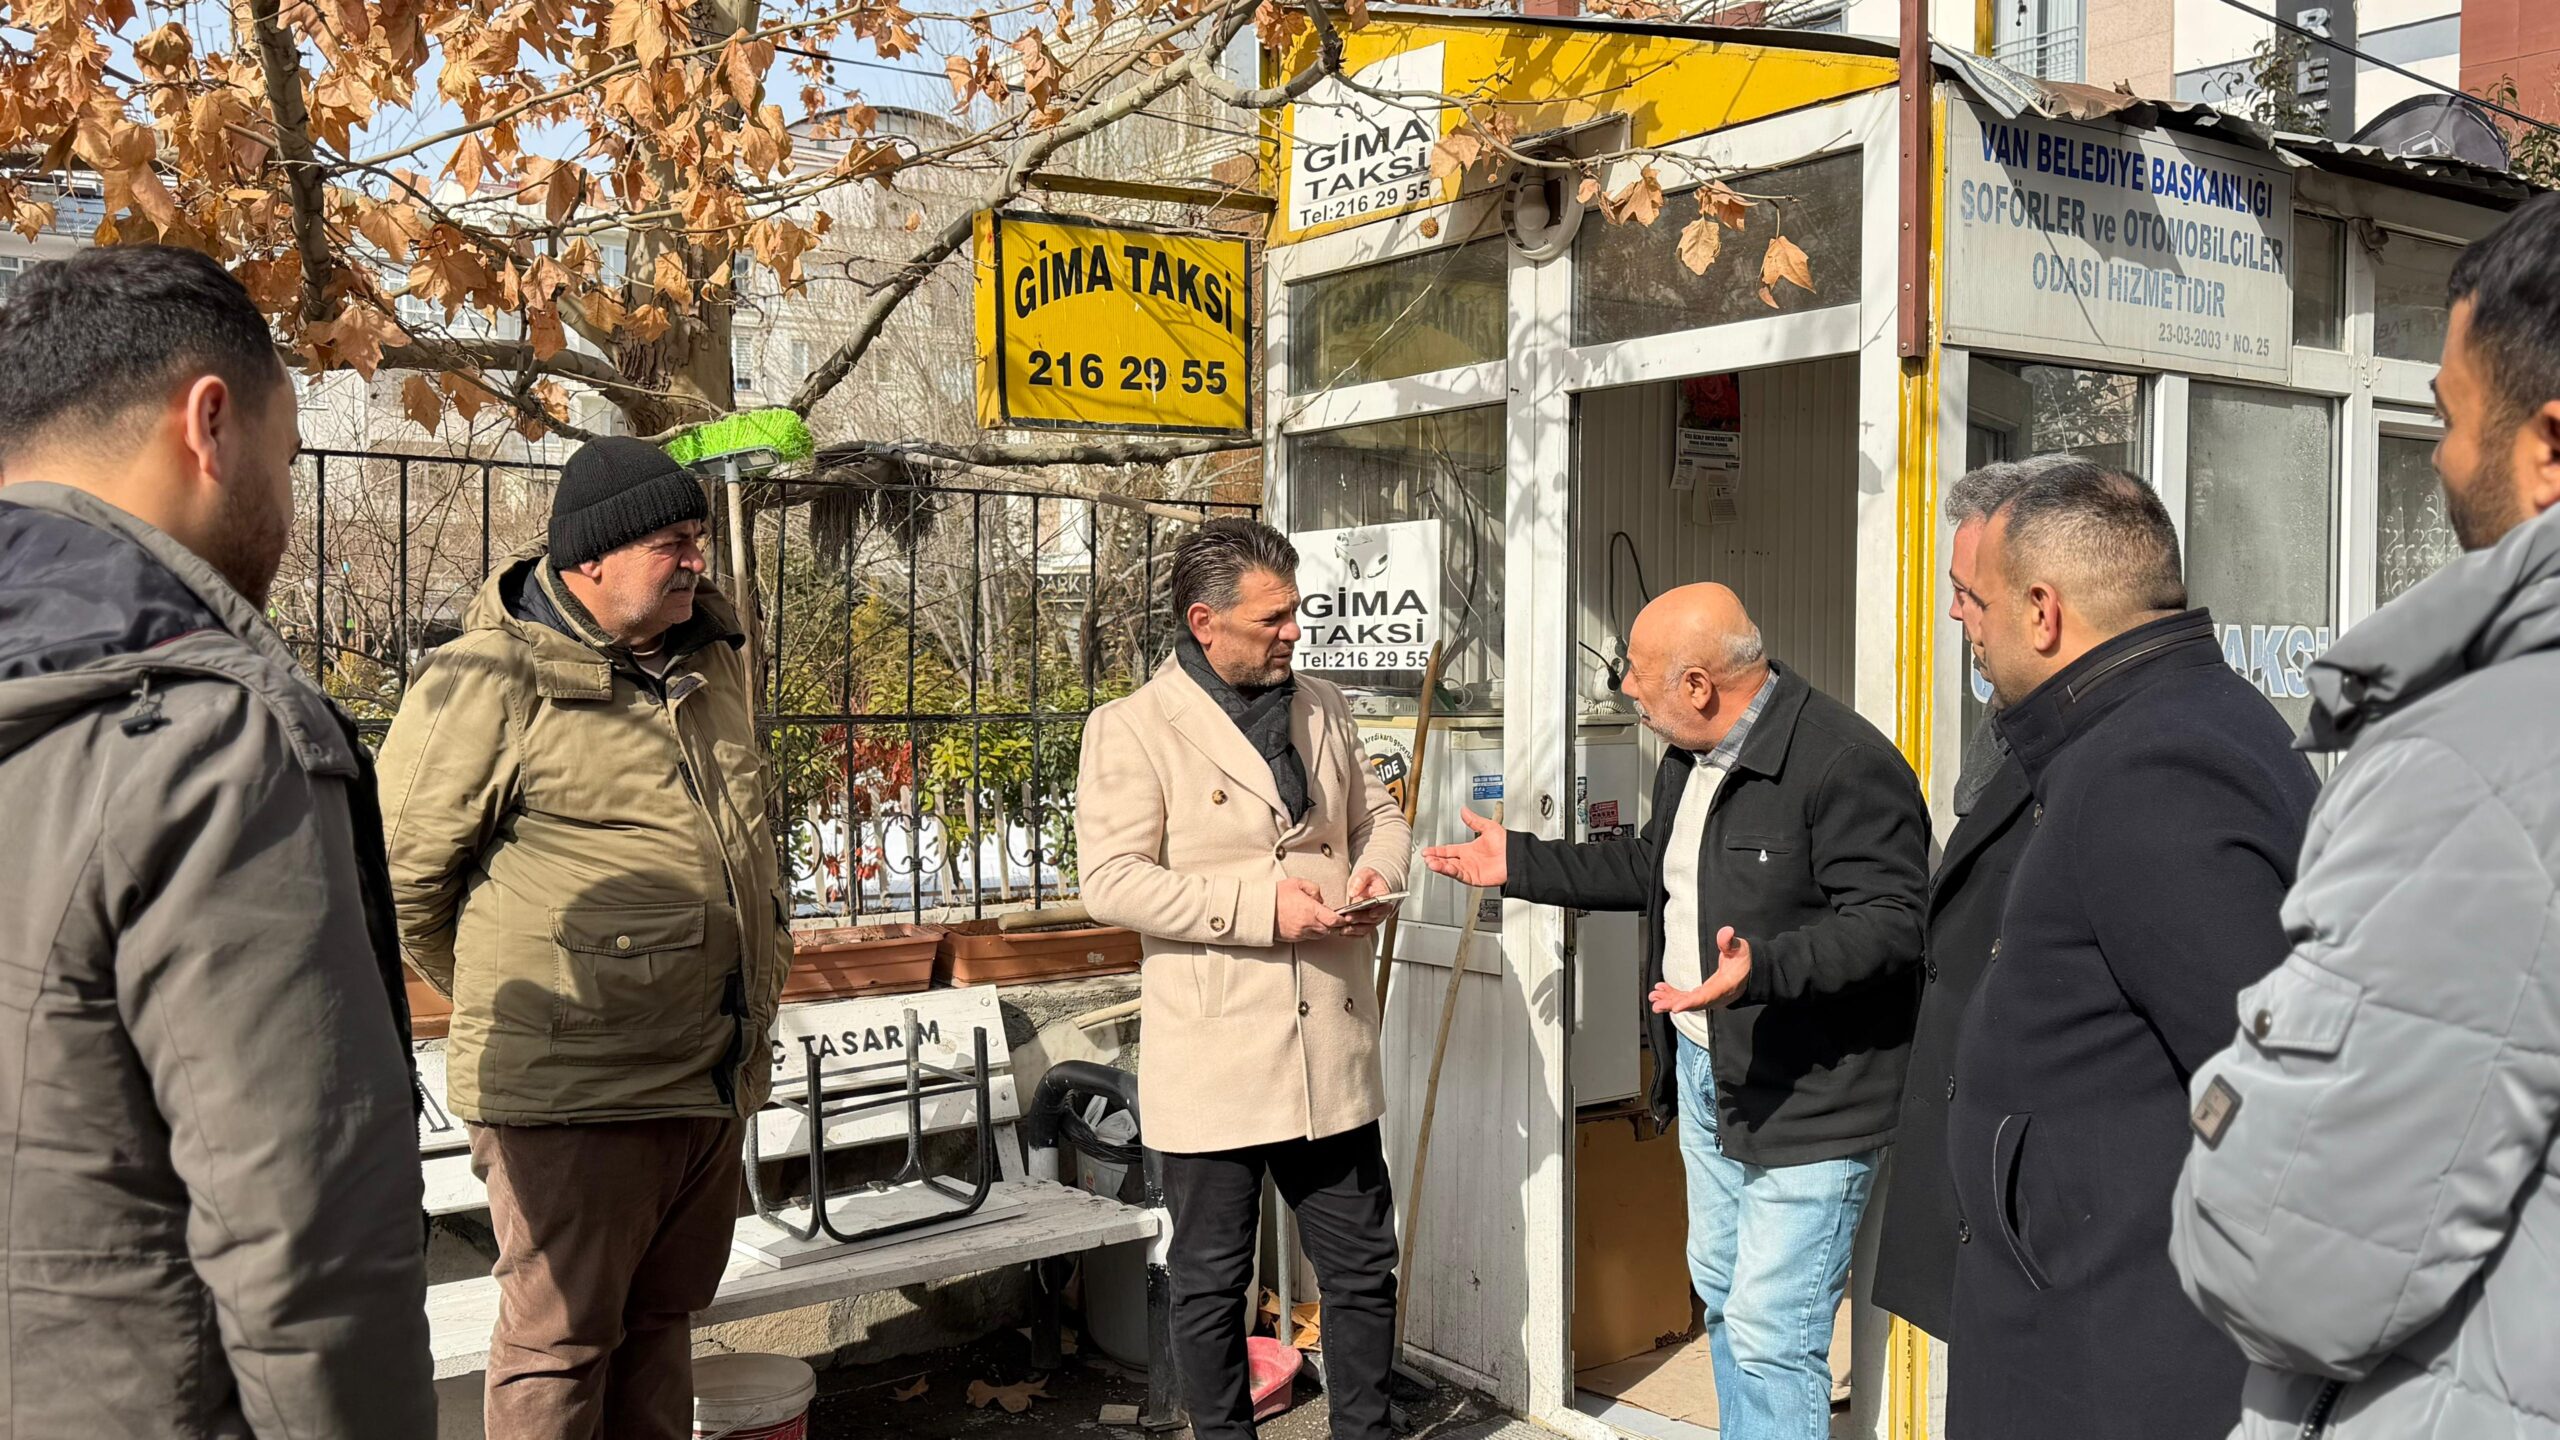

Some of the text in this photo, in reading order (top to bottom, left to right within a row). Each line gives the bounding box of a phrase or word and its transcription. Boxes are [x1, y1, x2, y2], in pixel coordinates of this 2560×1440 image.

[1304, 119, 1431, 173] GİMA
[1981, 120, 2273, 218] VAN BELEDİYE BAŞKANLIĞI
[1305, 147, 1426, 200] TAKSİ
[1300, 180, 1430, 226] Tel:216 29 55
[1961, 179, 2284, 275] ŞOFÖRLER ve OTOMOBİLCİLER
[1015, 239, 1233, 334] GİMA TAKSİ
[2032, 251, 2226, 318] ODASI HİZMETİDİR
[2233, 333, 2253, 355] NO.
[2256, 337, 2270, 356] 25
[1028, 350, 1227, 394] 216 29 55
[1300, 587, 1429, 618] GİMA
[1303, 618, 1424, 644] TAKSİ
[1299, 650, 1429, 667] Tel:216 29 55
[798, 1020, 941, 1060] TASARM
